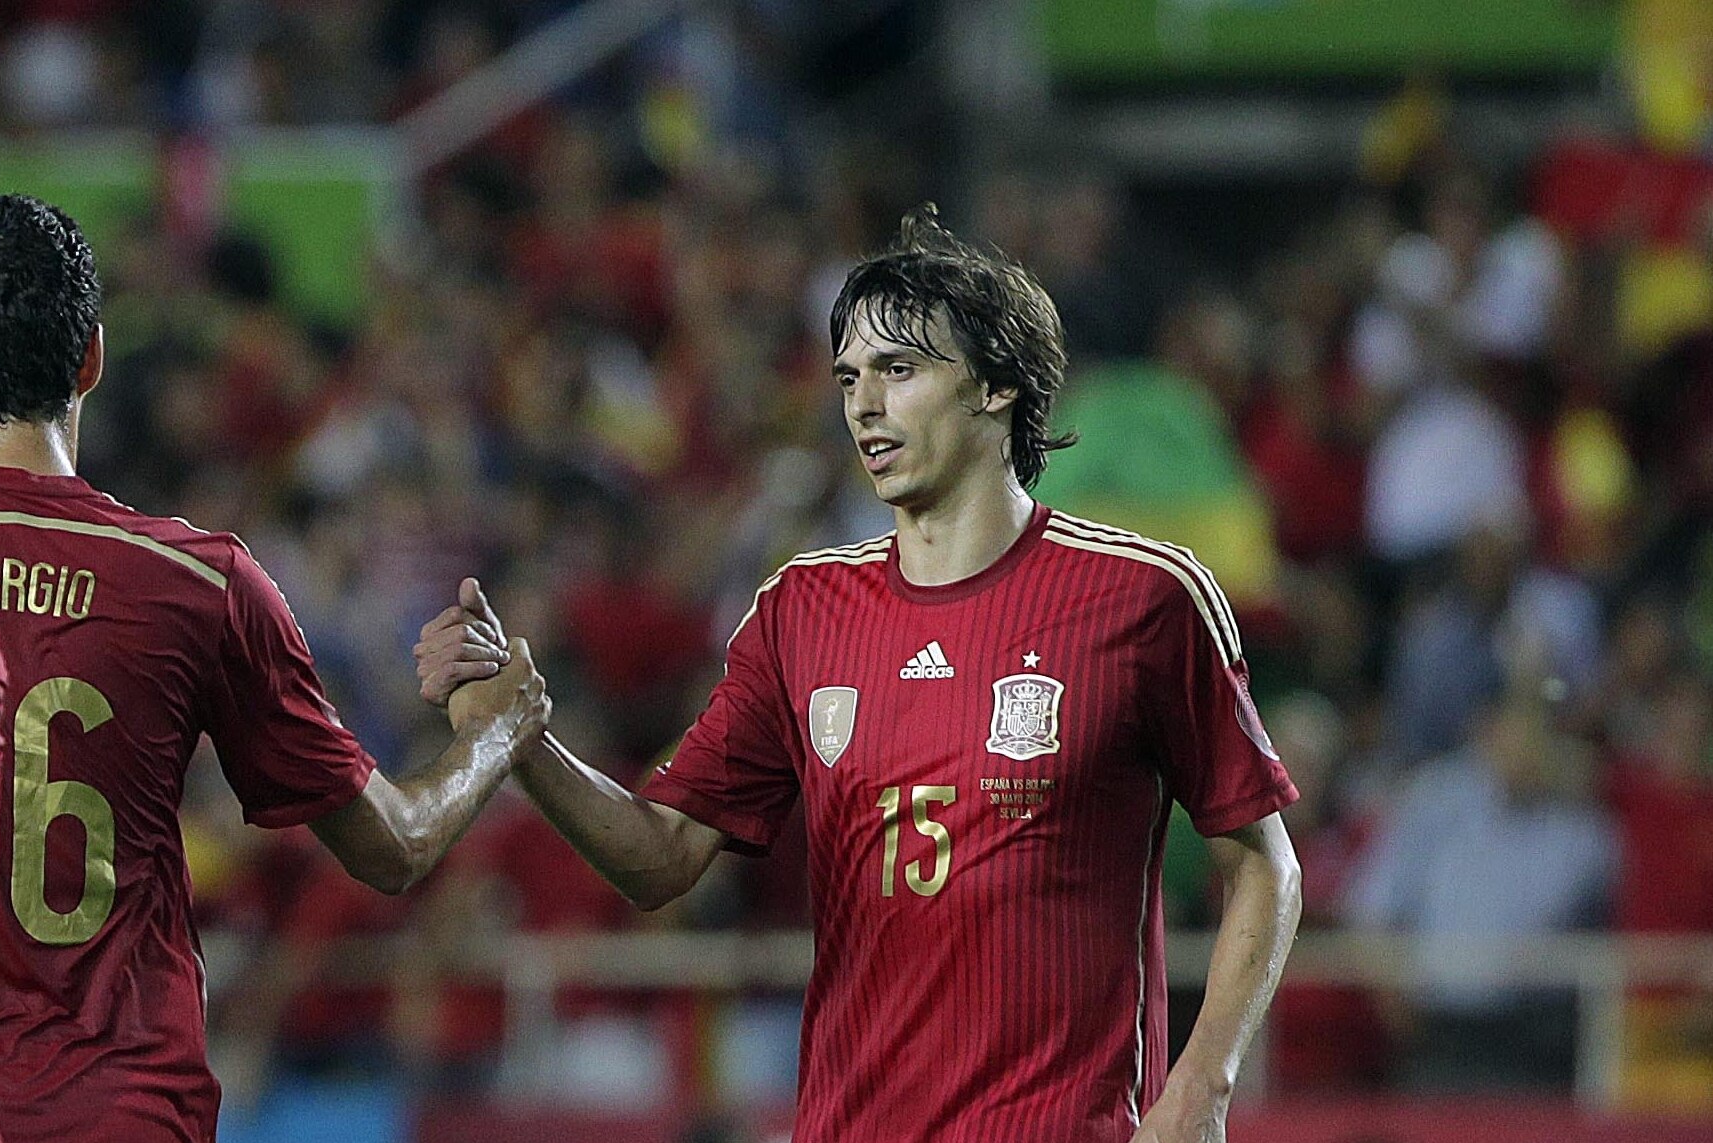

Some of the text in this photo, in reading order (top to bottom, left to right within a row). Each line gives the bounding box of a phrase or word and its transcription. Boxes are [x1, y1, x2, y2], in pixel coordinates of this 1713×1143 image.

[899, 664, 955, 680] adidas
[10, 676, 116, 944] 6
[980, 776, 1010, 791] ESPAÑA
[1013, 778, 1024, 790] VS
[875, 785, 956, 897] 15
